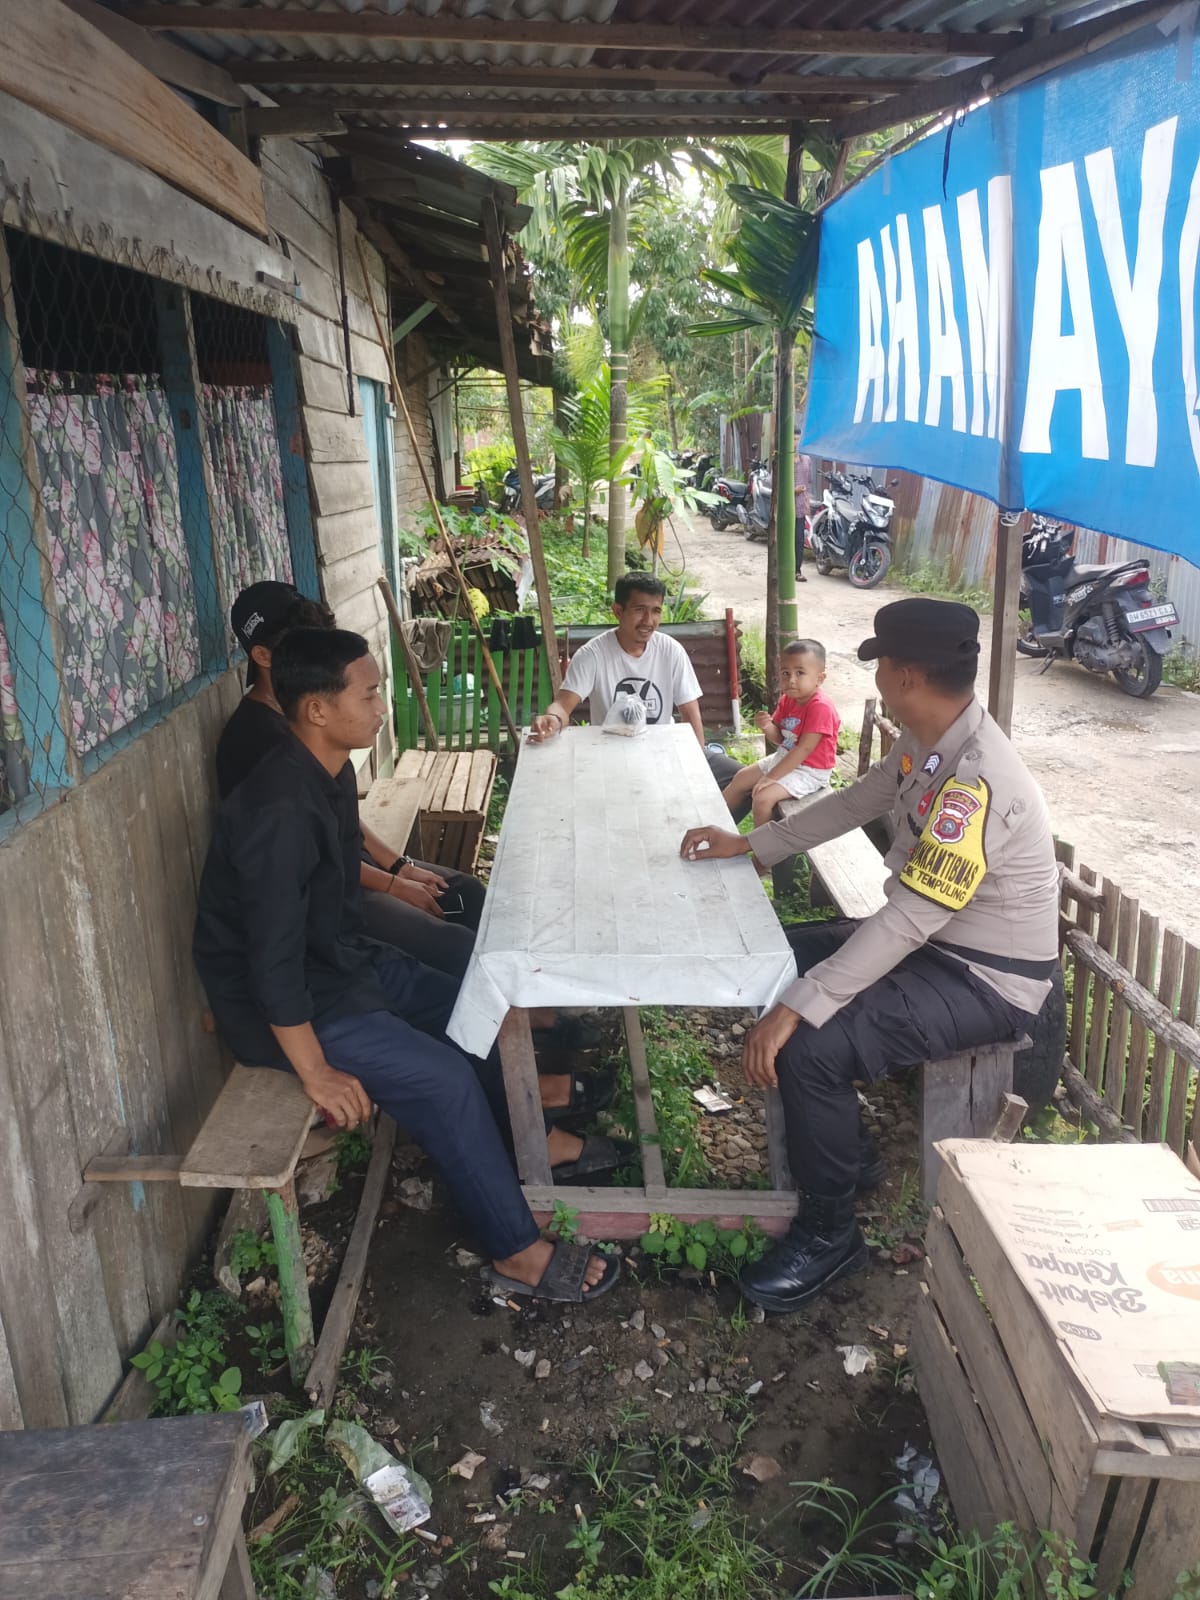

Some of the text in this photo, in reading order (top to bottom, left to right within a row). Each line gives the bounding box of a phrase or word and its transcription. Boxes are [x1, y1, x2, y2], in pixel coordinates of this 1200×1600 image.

[917, 870, 967, 902] TEMPULING
[1022, 1252, 1128, 1286] Kelapa
[1034, 1278, 1147, 1317] Biskuit
